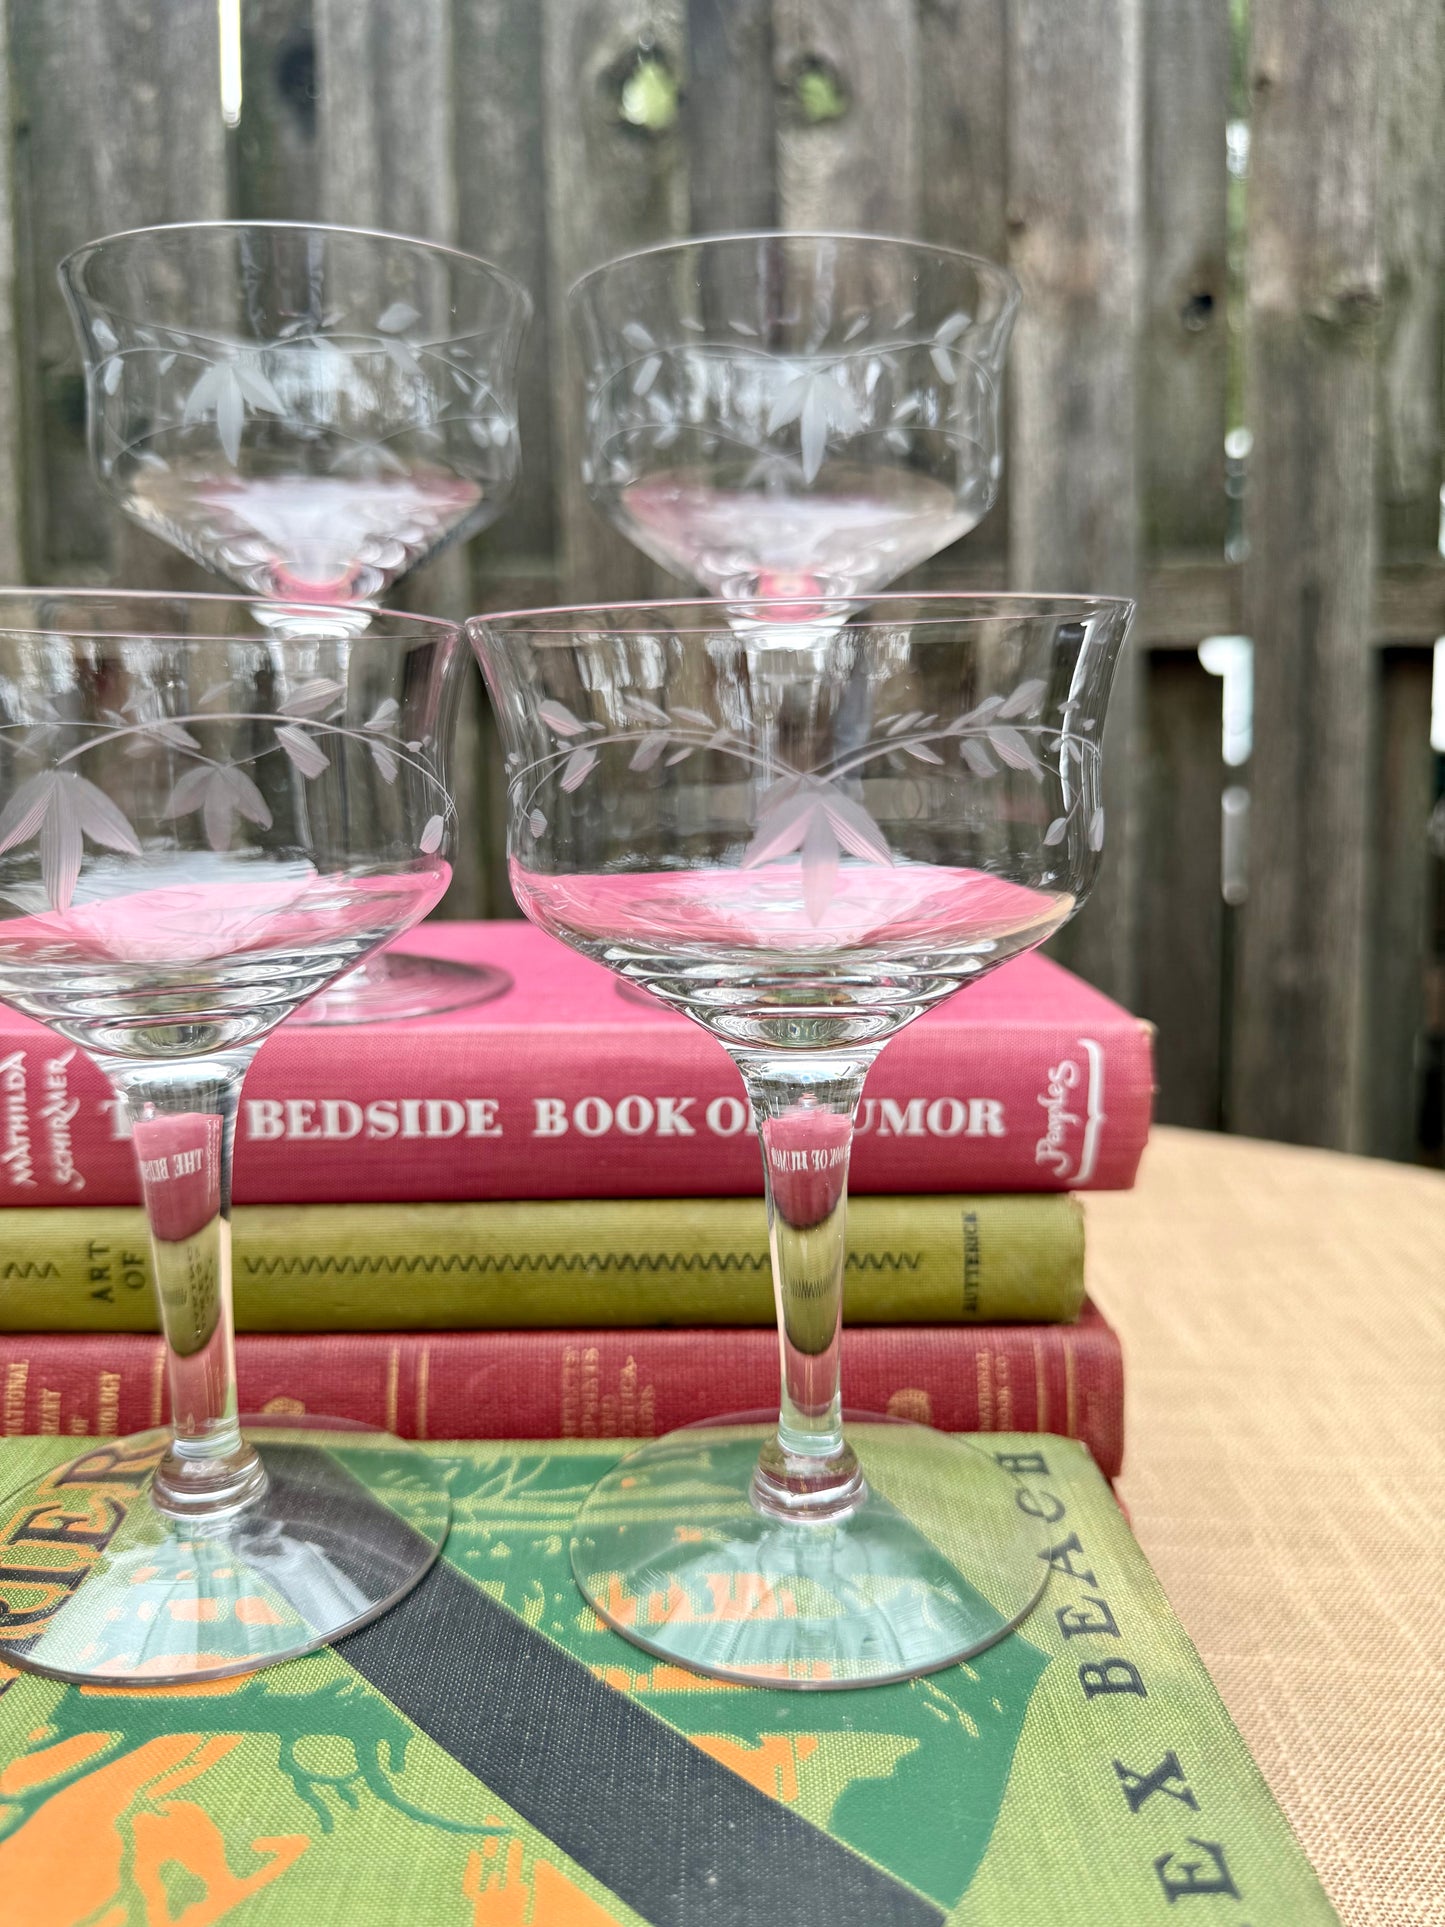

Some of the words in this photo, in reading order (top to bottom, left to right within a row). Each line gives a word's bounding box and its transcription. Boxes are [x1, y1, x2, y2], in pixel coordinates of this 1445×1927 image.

[0, 1051, 36, 1187] MATHILDA
[37, 1048, 86, 1192] SCHIRMER
[247, 1098, 503, 1140] BEDSIDE
[533, 1096, 694, 1138] BOOK
[87, 1240, 114, 1303] ART
[121, 1250, 145, 1290] OF
[962, 1210, 980, 1312] BUTTERICK
[994, 1451, 1148, 1699] BEACH
[1112, 1750, 1242, 1904] EX
